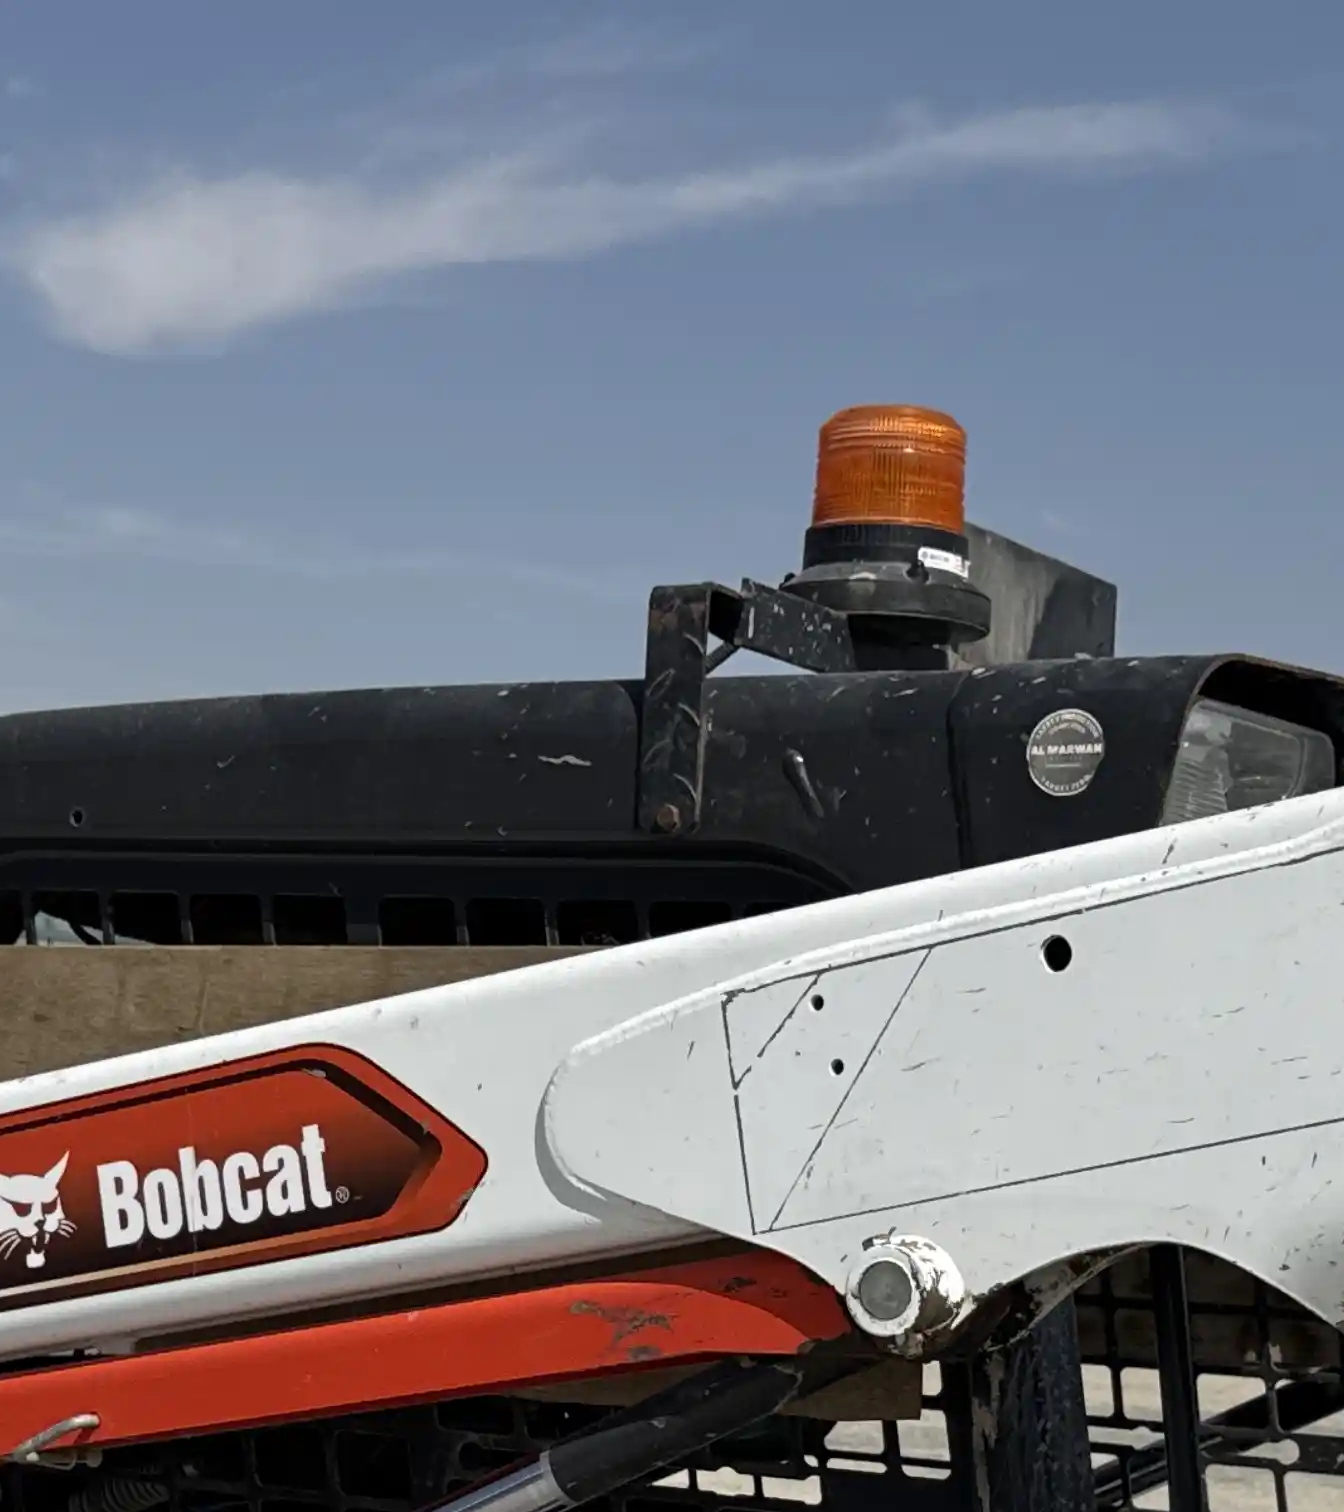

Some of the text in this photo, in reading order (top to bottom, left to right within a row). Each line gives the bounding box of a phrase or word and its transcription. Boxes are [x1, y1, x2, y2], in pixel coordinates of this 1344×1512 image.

[1031, 743, 1103, 755] AL MARWAN
[97, 1124, 332, 1248] Bobcat
